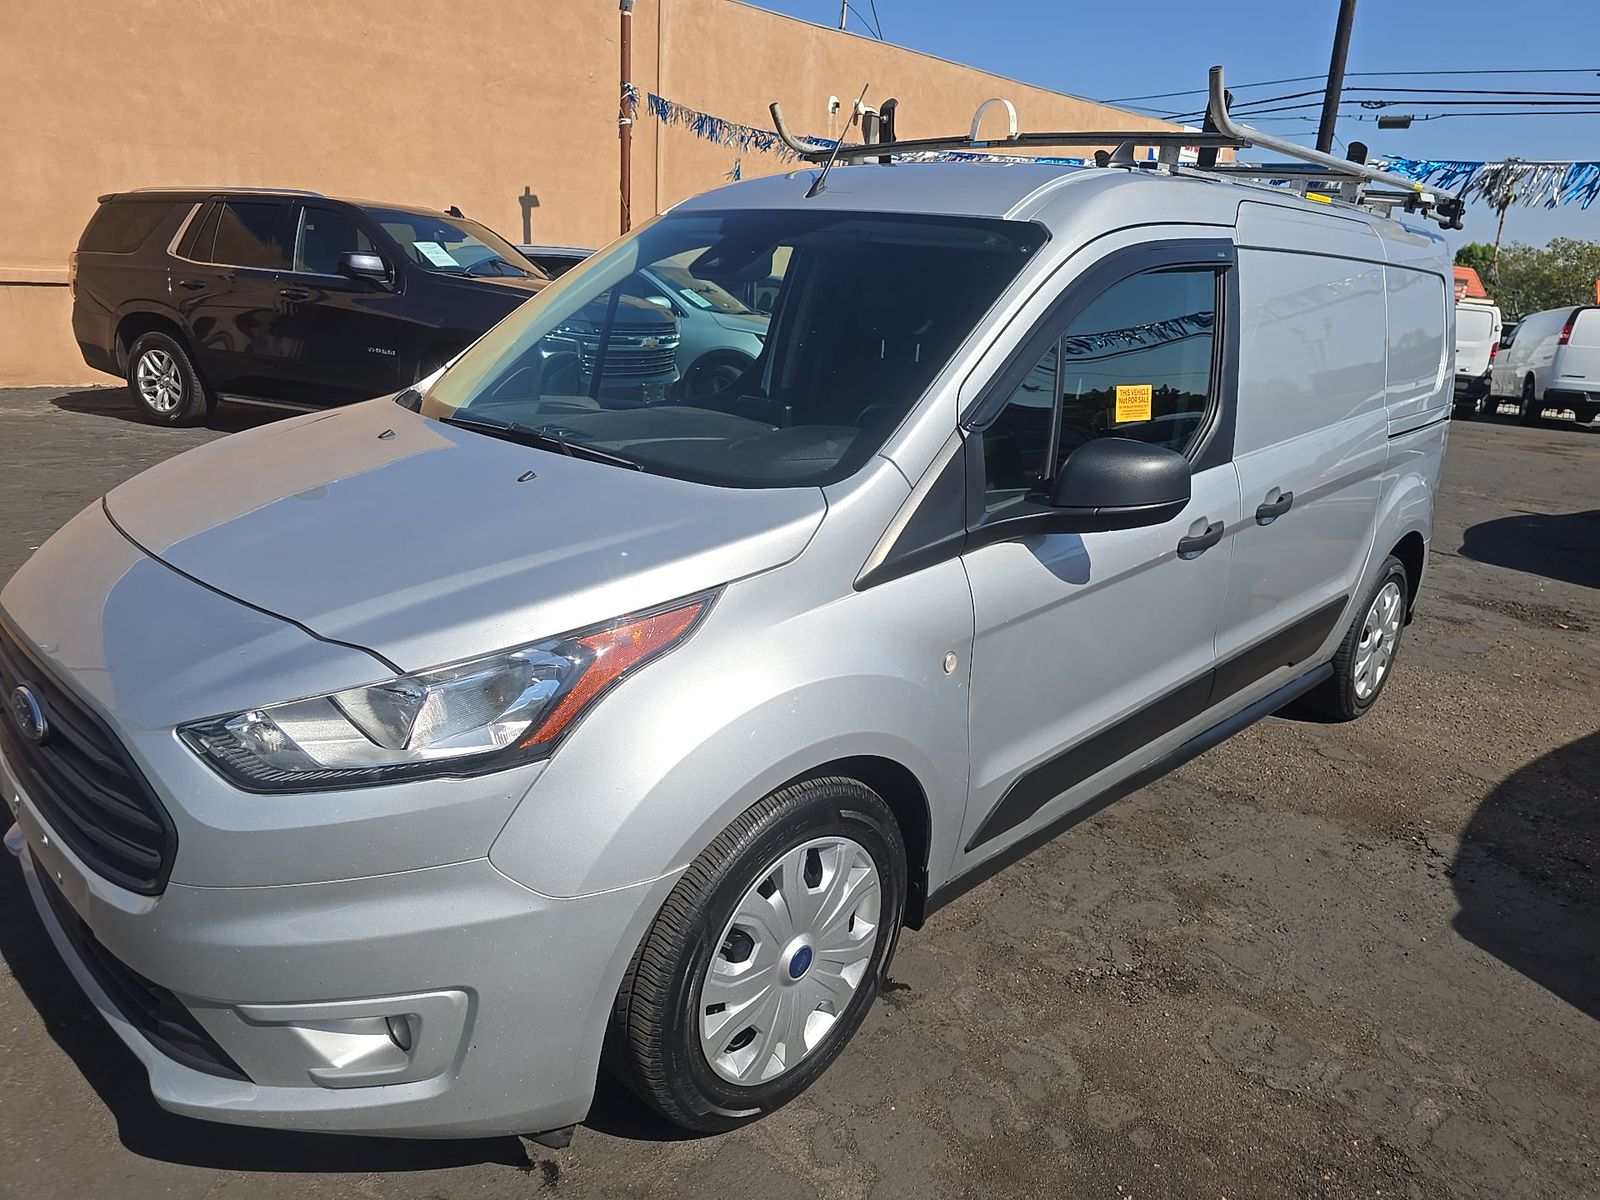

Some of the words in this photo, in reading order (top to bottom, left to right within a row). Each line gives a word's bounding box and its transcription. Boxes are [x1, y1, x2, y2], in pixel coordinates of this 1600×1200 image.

[1119, 389, 1130, 397] THIS
[1131, 388, 1150, 396] VEHICLE
[1128, 396, 1137, 404] FOR
[1138, 396, 1149, 404] SALE
